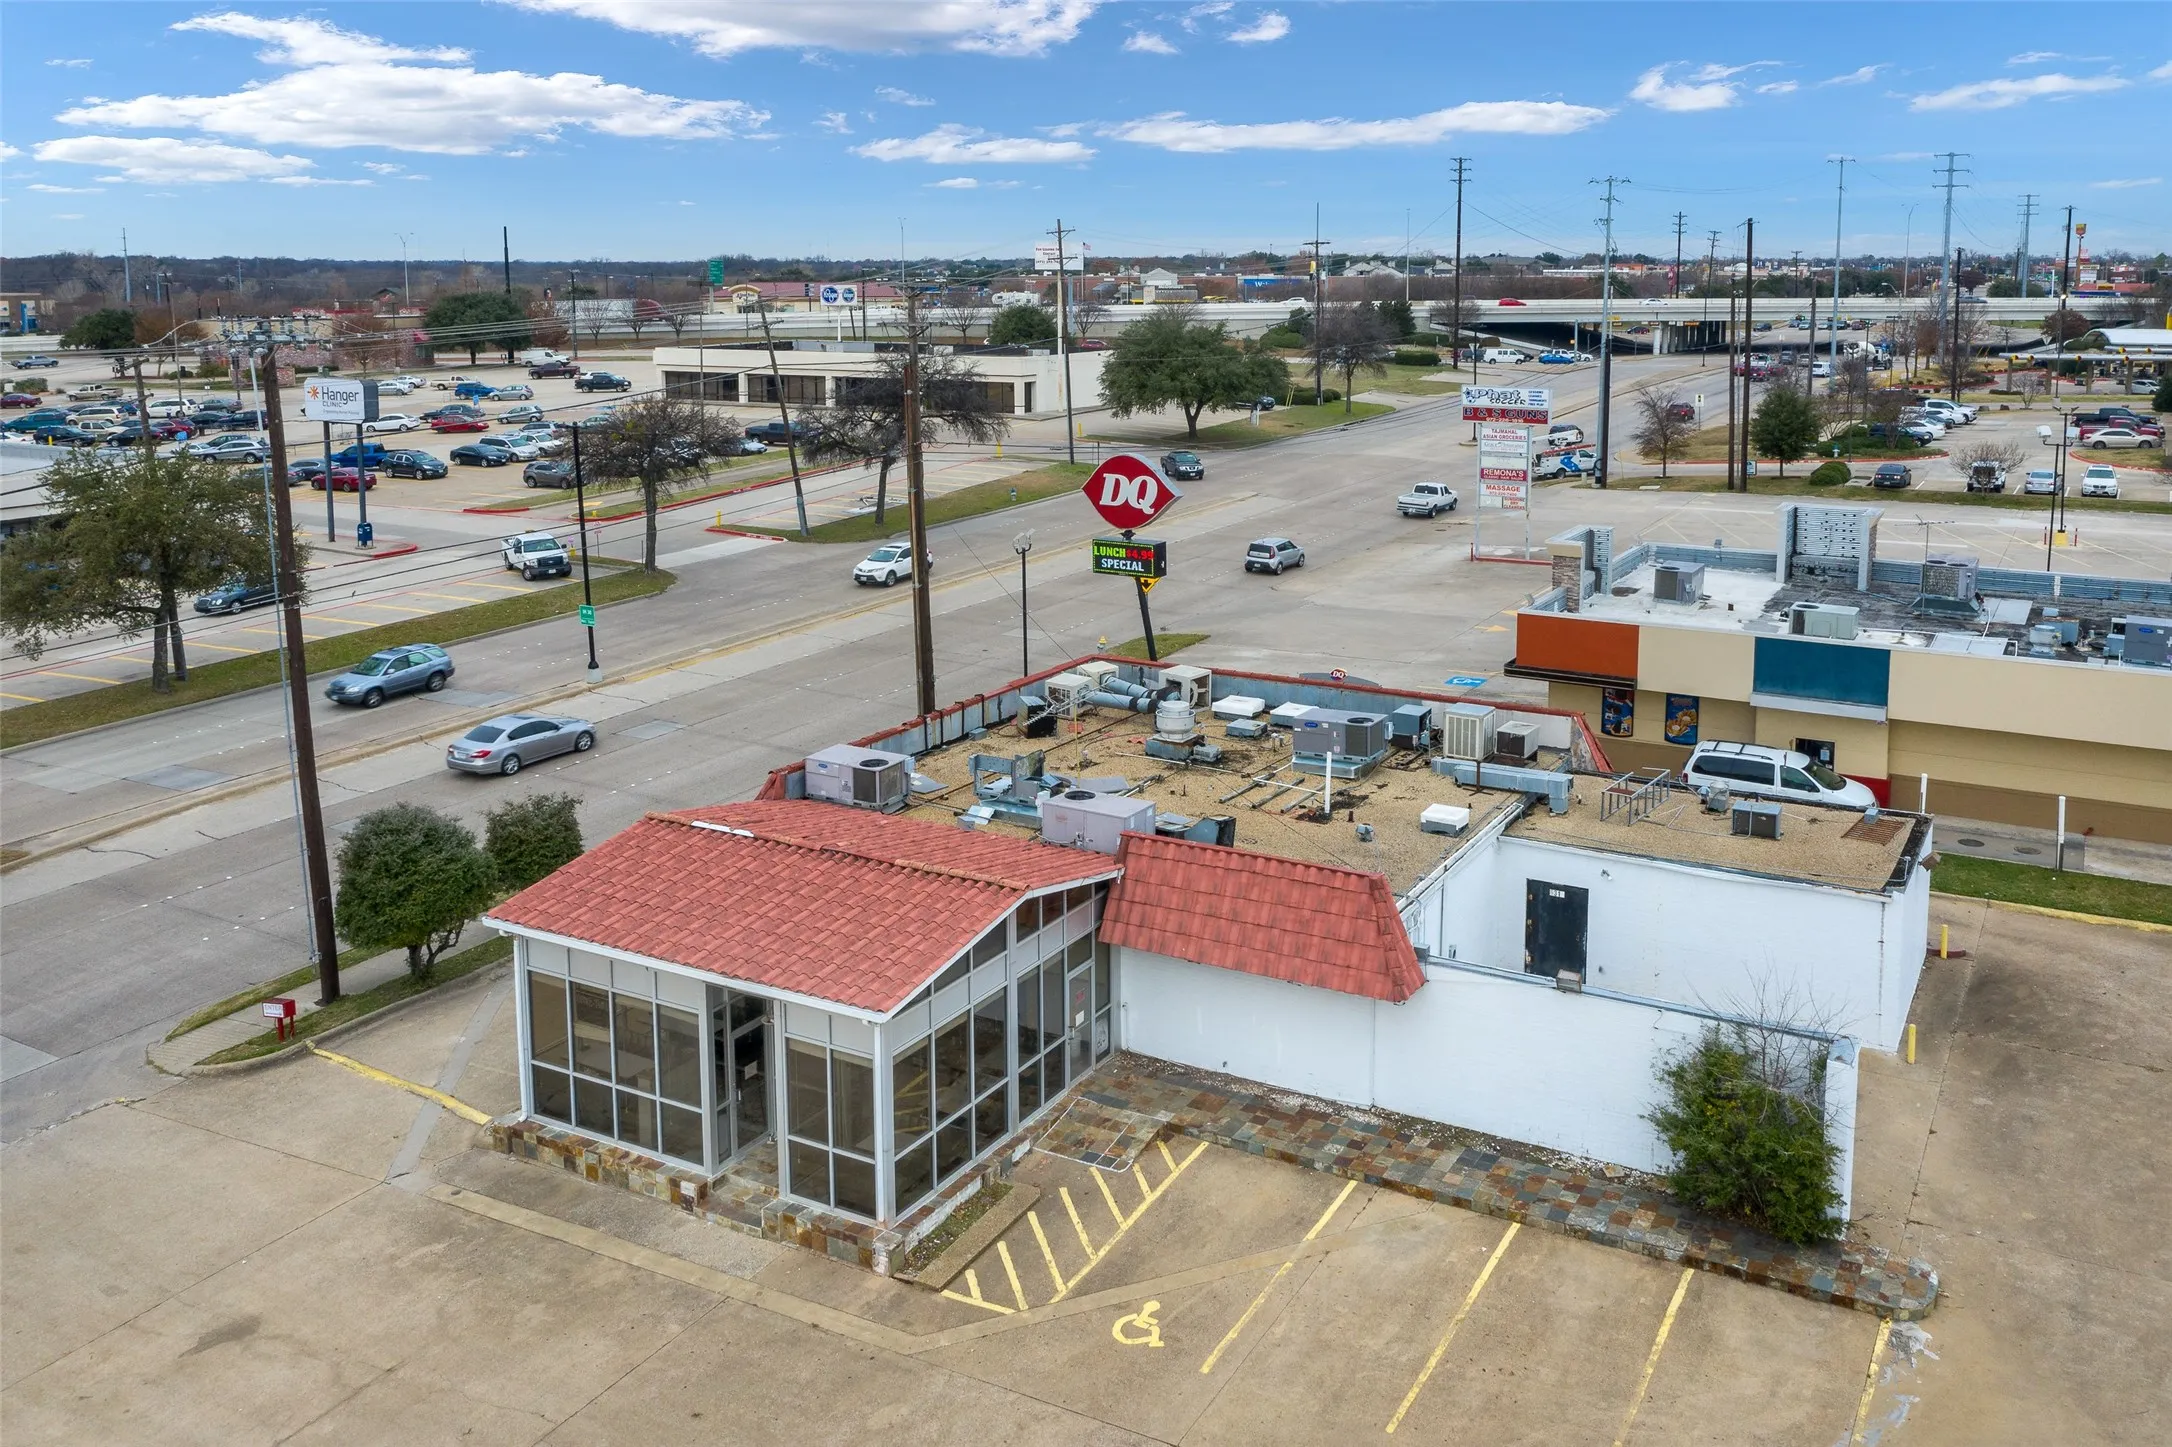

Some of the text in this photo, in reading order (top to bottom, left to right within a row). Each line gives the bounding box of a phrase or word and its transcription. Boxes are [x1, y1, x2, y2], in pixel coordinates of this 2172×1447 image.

[322, 386, 359, 405] Hanger
[1471, 388, 1521, 400] Phat
[1464, 407, 1548, 420] B & S GUNS
[1484, 469, 1524, 477] REMONA'S
[1099, 473, 1158, 515] DQ
[1094, 546, 1154, 560] LUNCH $4.99
[1102, 558, 1144, 572] SPECIAL
